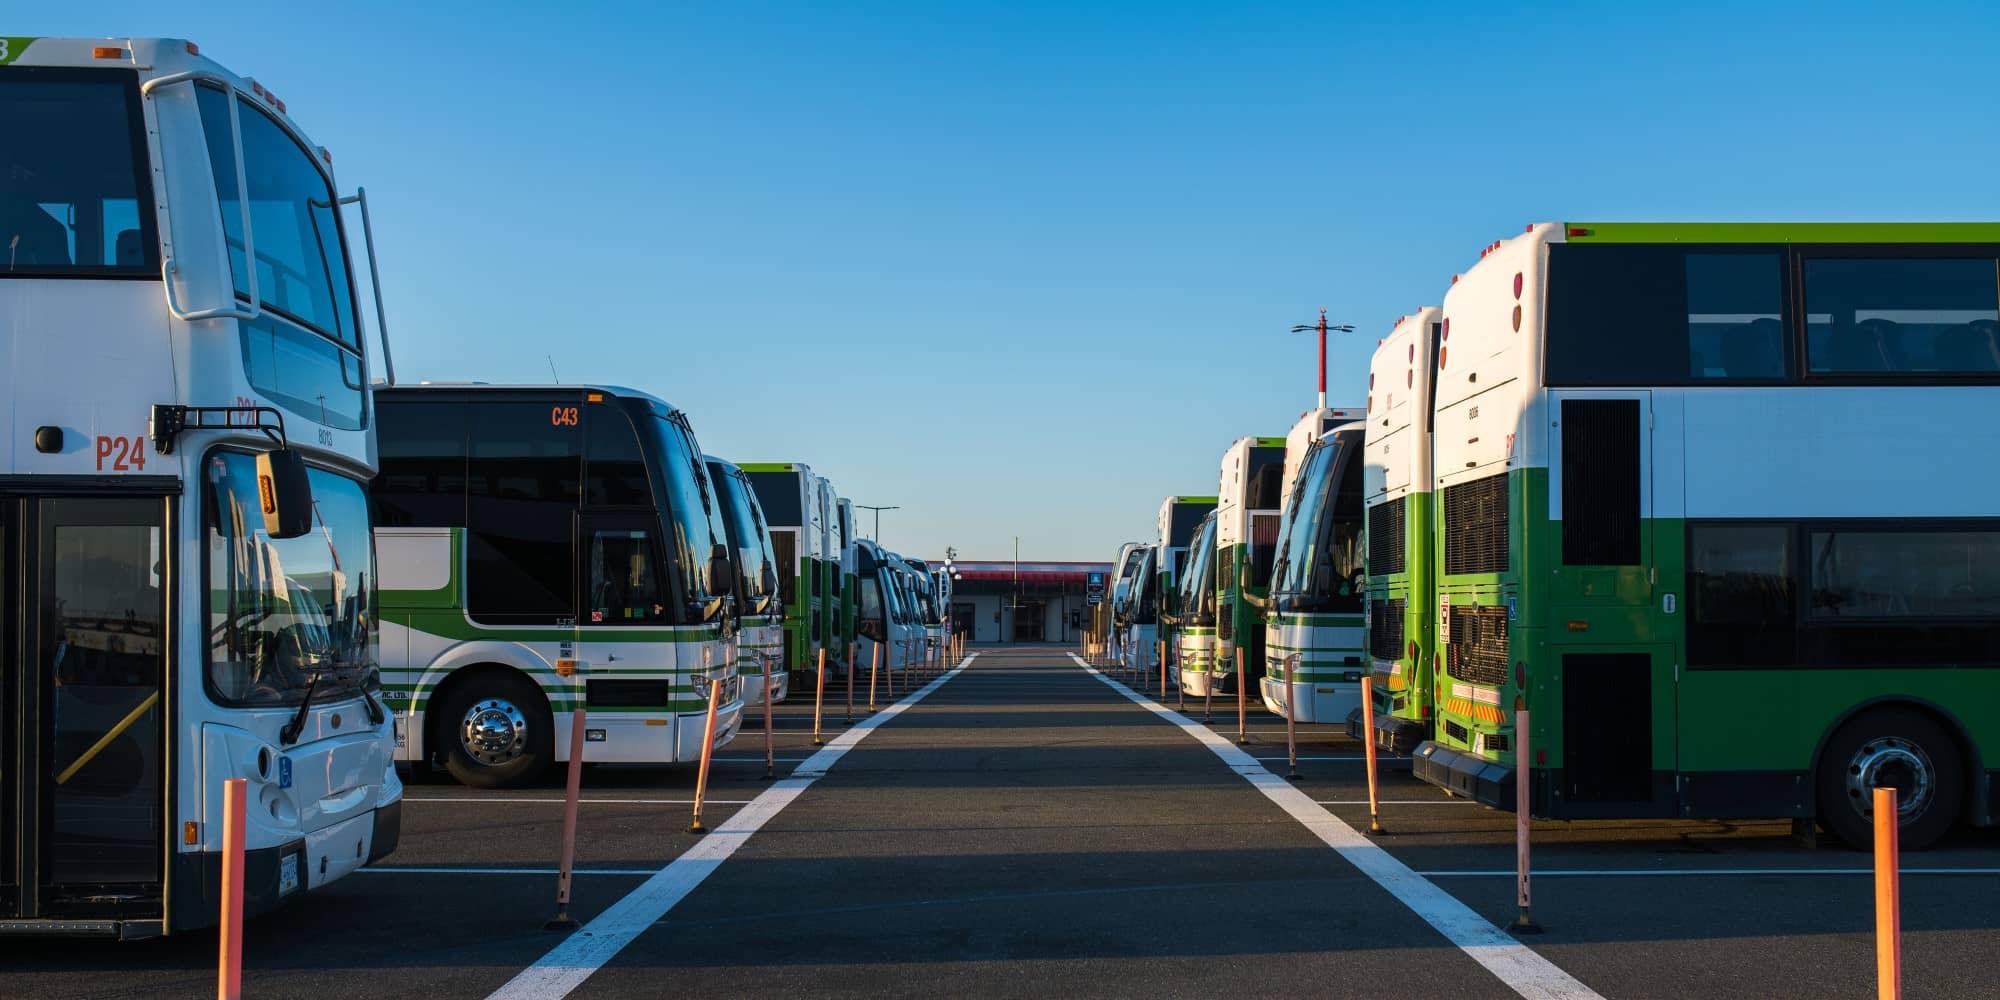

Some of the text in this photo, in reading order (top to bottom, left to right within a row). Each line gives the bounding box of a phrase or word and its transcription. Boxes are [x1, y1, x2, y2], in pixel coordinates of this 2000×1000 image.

[552, 407, 578, 426] C43
[318, 428, 333, 447] 8013
[96, 436, 146, 471] P24
